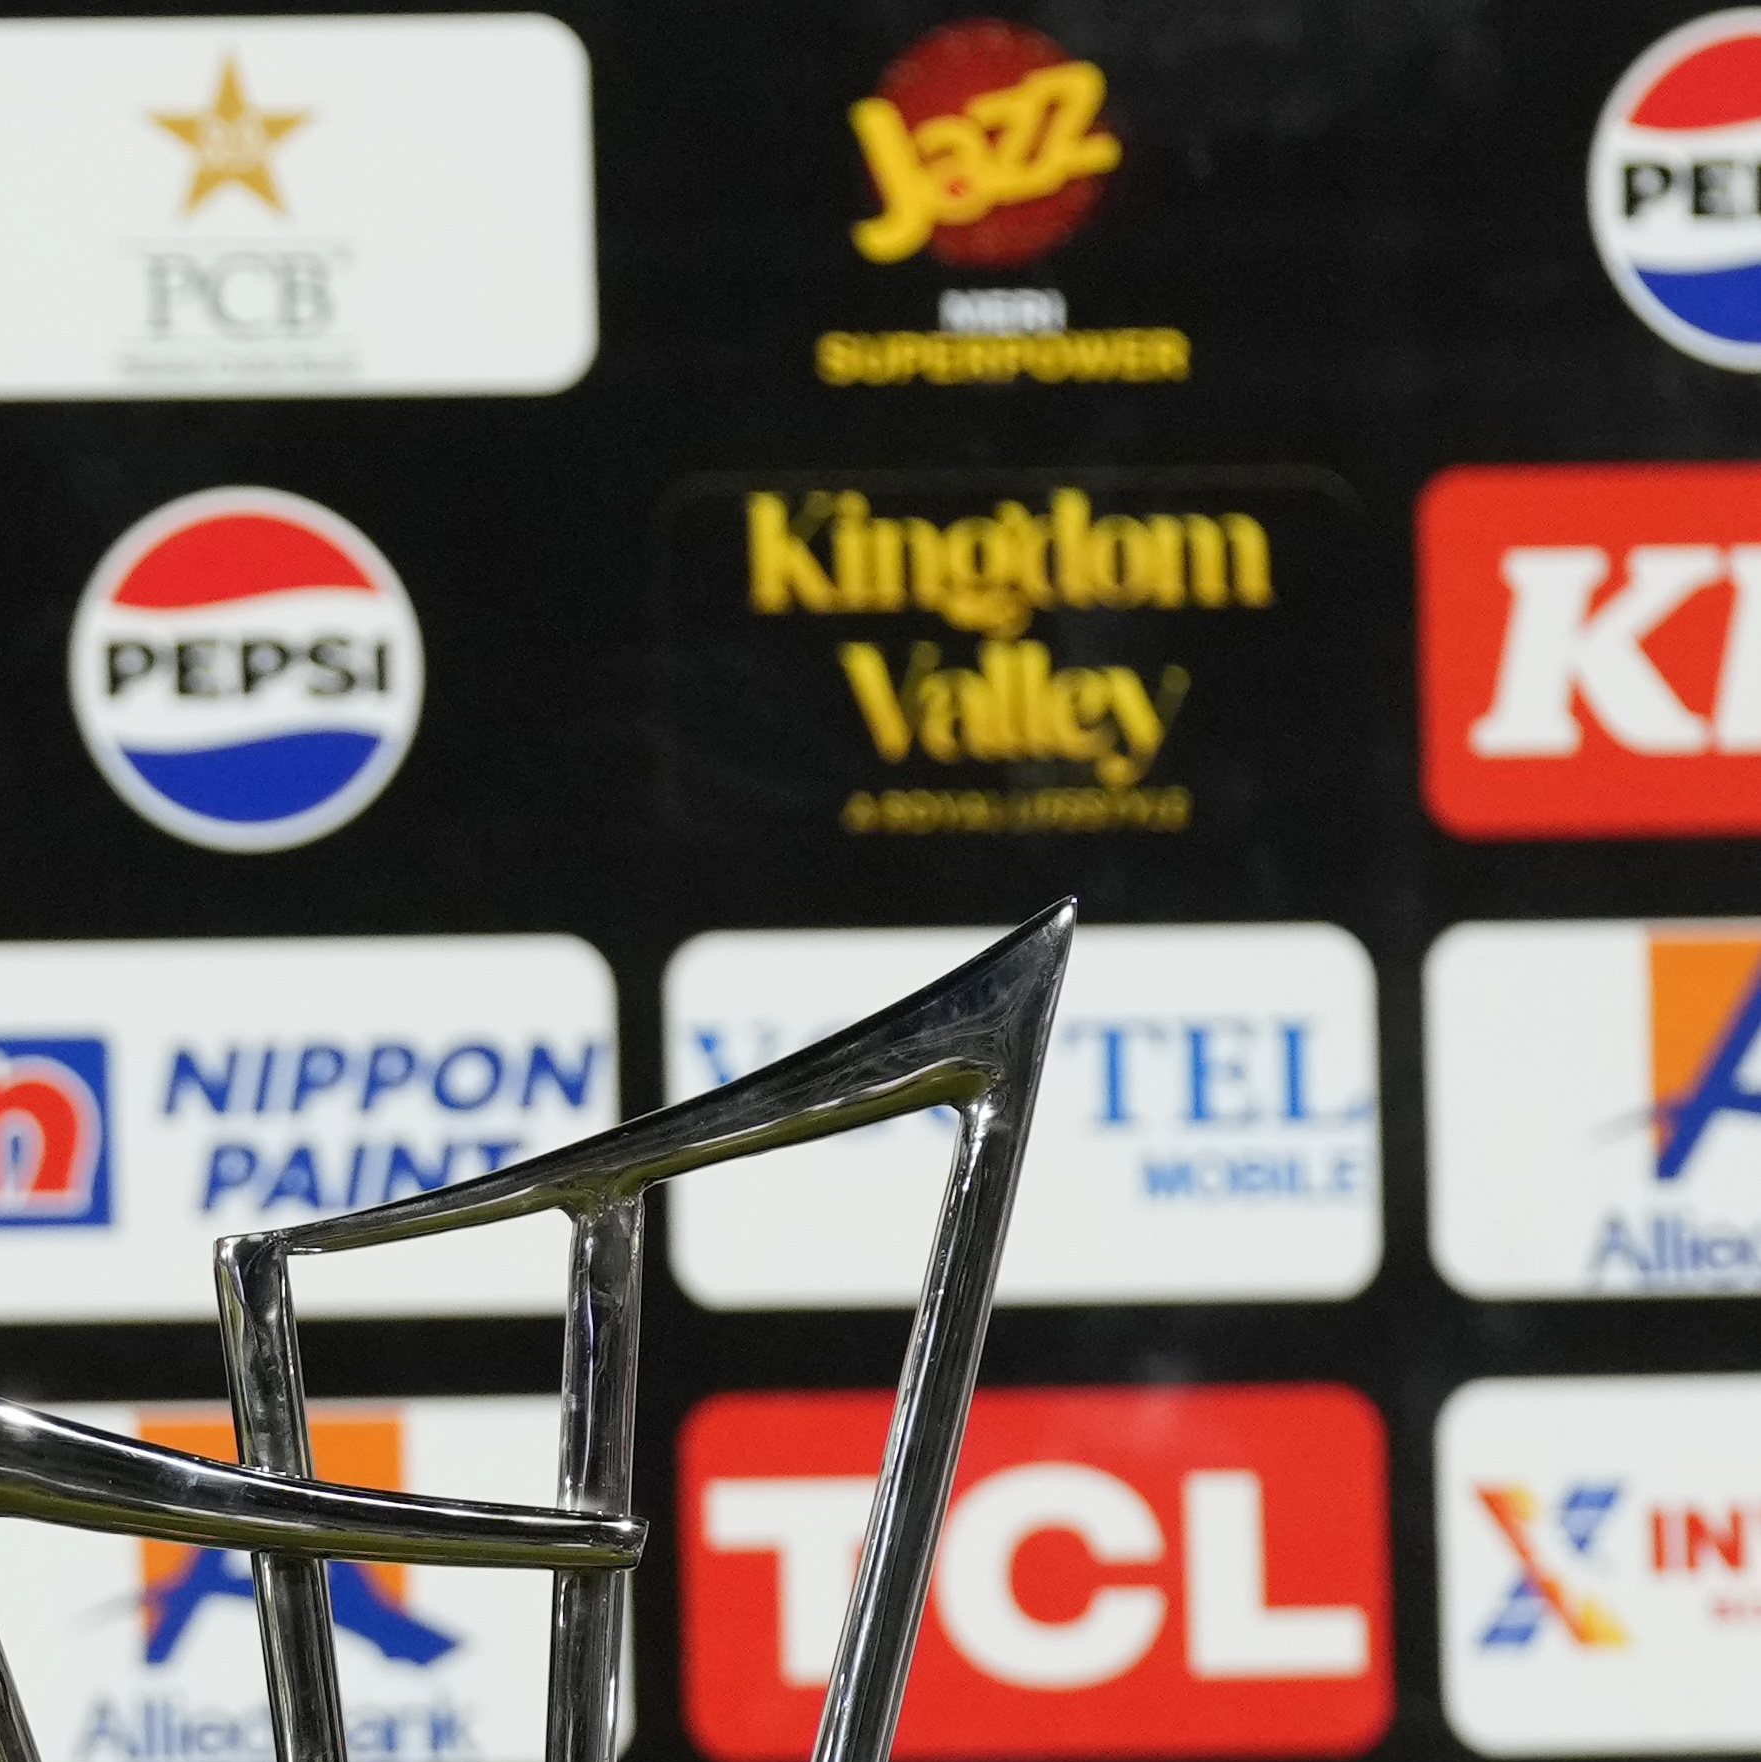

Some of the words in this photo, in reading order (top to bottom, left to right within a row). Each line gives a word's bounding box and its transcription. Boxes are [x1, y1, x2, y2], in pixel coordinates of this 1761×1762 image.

[848, 60, 1121, 264] Jazz
[146, 251, 338, 341] PCB
[815, 329, 1190, 384] SUPERPOWER
[744, 487, 1273, 634] Kingdom
[104, 635, 394, 699] PEPSI
[839, 640, 1190, 787] Valley
[163, 1039, 603, 1116] NIPPON
[1061, 1016, 1370, 1127] TEL
[1140, 1149, 1365, 1202] MOBILE
[702, 1460, 1369, 1691] TCL
